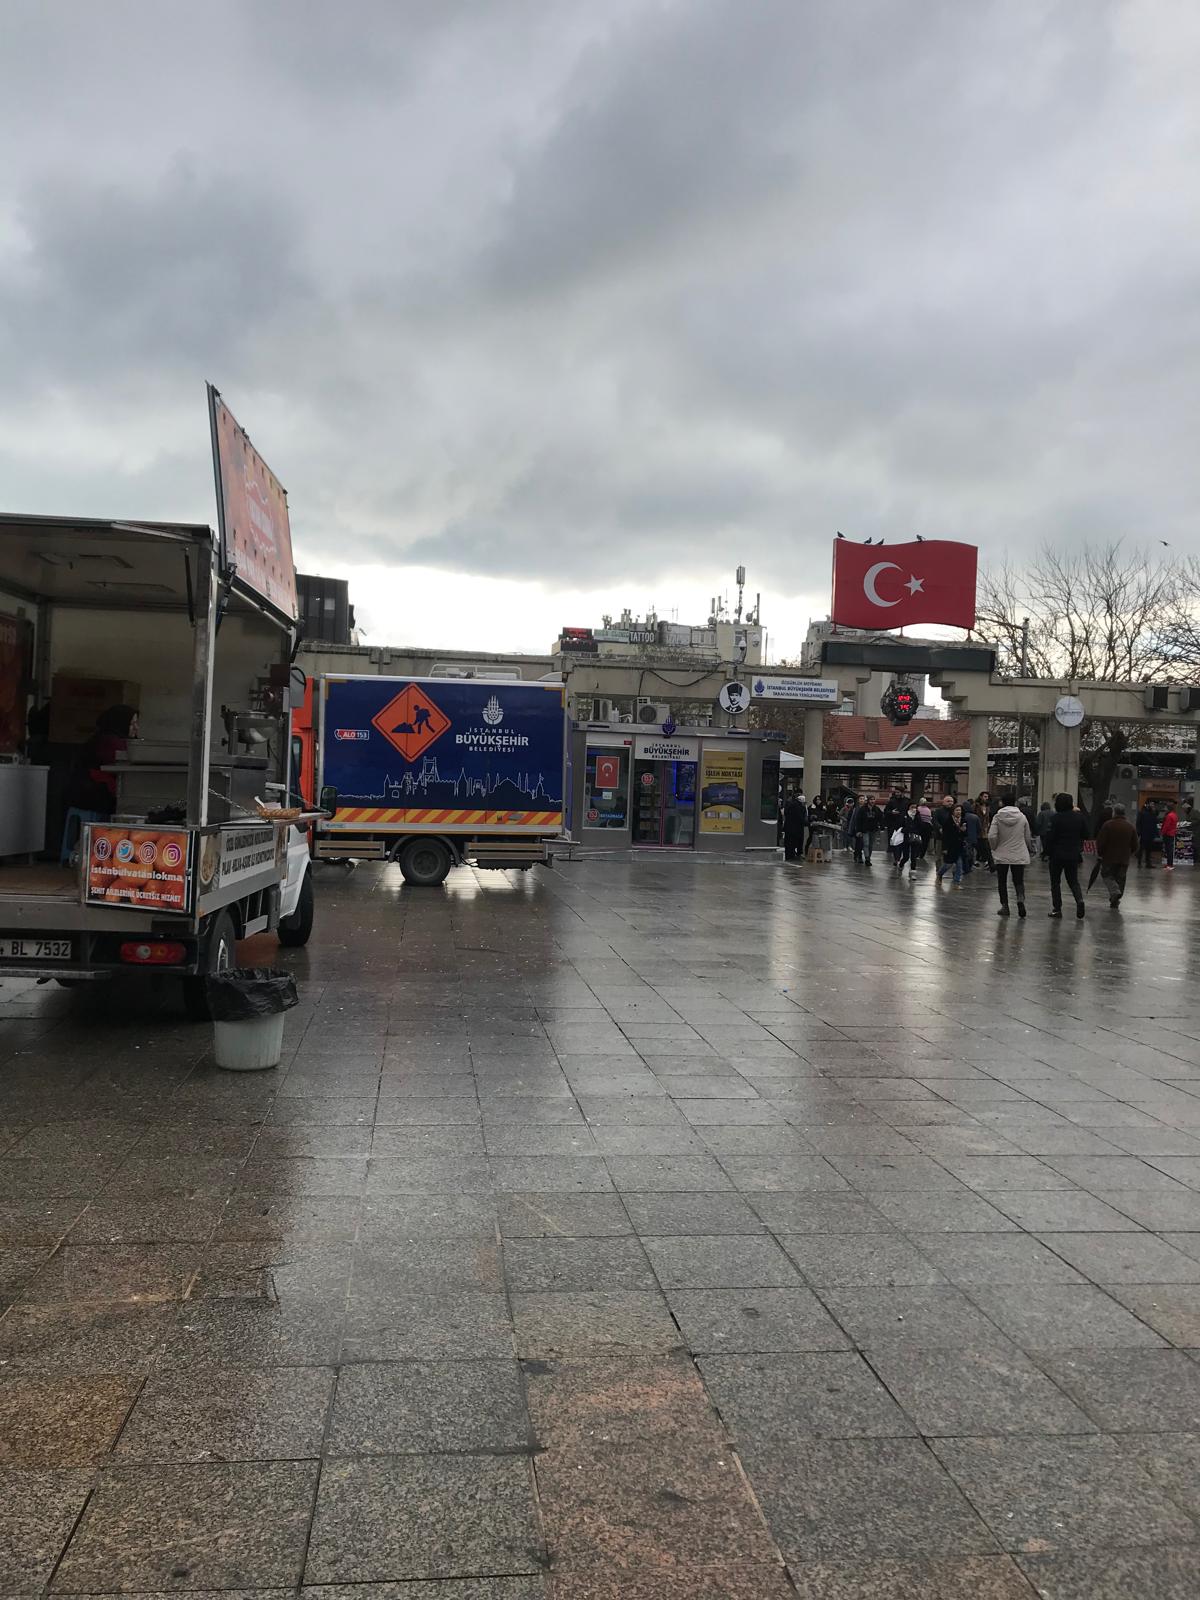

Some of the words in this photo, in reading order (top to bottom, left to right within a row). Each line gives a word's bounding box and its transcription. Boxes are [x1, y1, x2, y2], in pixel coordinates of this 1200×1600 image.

[630, 632, 655, 643] TATTOO
[356, 731, 367, 739] 153
[455, 732, 529, 747] BÜYÜKŞEHİR
[643, 746, 690, 757] BÜYÜKŞEHİR
[11, 941, 28, 956] BL
[35, 941, 71, 957] 7532
